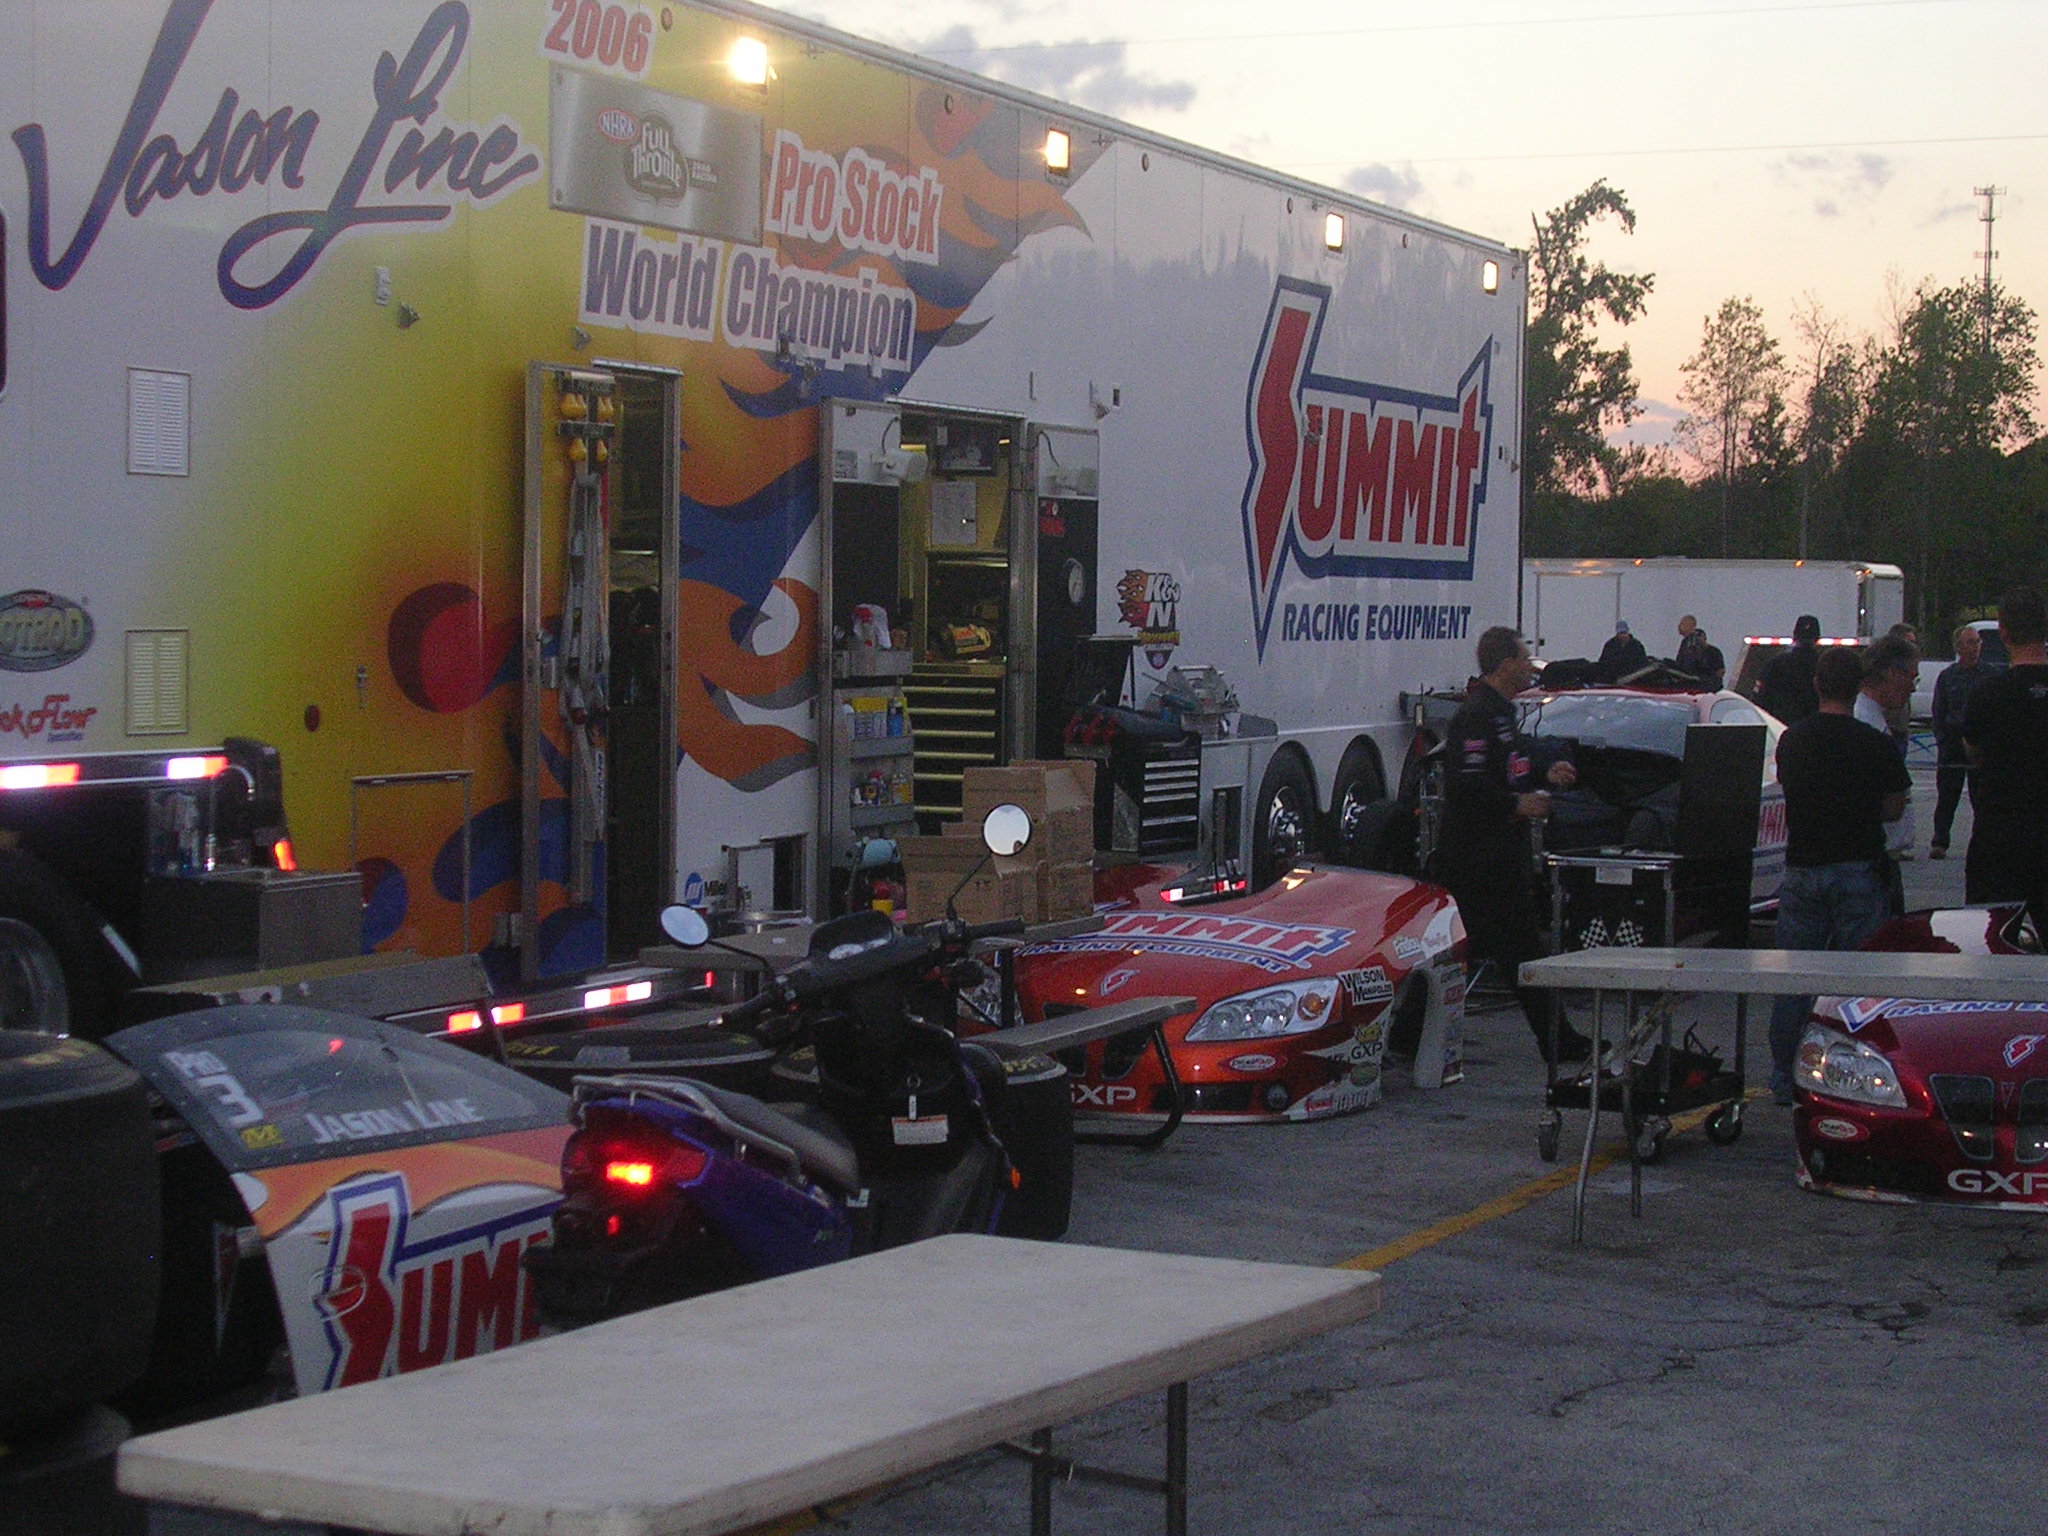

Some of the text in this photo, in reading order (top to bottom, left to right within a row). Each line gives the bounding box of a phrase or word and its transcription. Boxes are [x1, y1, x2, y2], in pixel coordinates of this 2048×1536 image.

[545, 0, 652, 73] 2006
[600, 110, 636, 139] NHRA
[12, 0, 540, 309] Jason Line
[773, 140, 939, 254] Pro Stock
[586, 223, 916, 361] World Champion
[1282, 603, 1472, 641] RACING EQUIPMENT
[1342, 968, 1385, 988] WILSON
[1884, 1002, 2013, 1019] RACING
[1350, 1042, 1383, 1060] GXP
[199, 1074, 264, 1127] 3
[1071, 1084, 1137, 1105] XP
[305, 1105, 413, 1144] JASON
[1946, 1168, 2048, 1196] GXP
